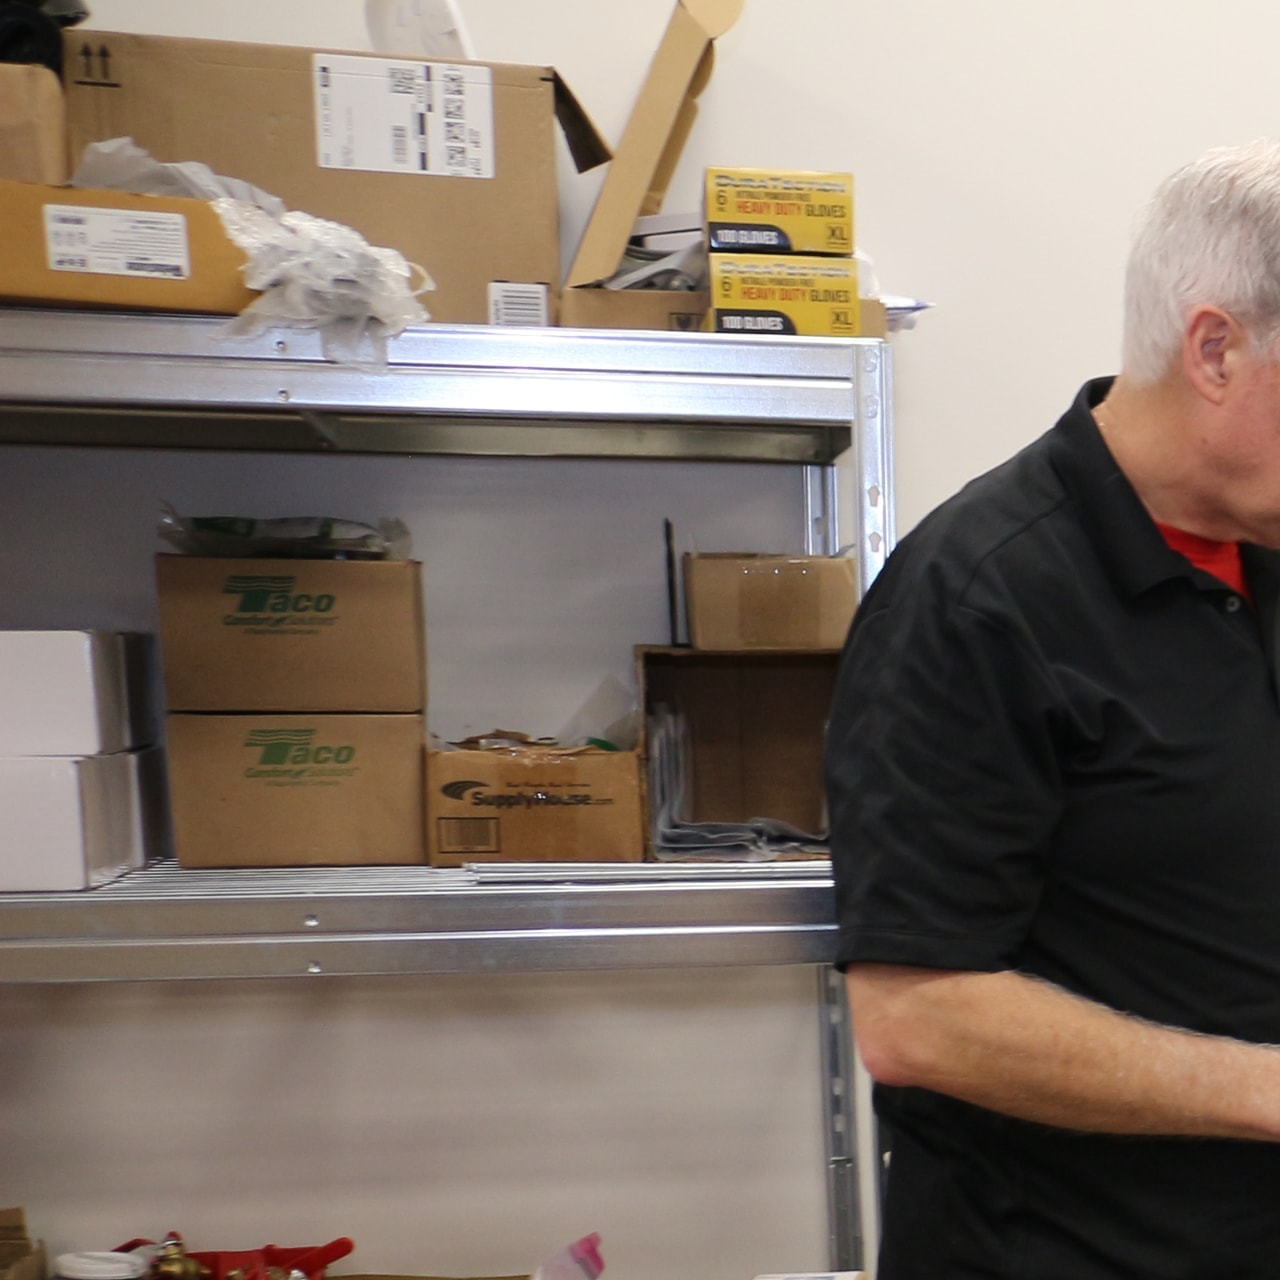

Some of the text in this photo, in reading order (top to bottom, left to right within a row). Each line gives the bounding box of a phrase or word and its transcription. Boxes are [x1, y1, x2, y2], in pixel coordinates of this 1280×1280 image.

[736, 202, 772, 214] HEAVY
[775, 203, 802, 216] DUTY
[805, 205, 847, 218] GLOVES
[716, 230, 779, 245] 100 GLOVES
[827, 227, 848, 241] XL
[741, 287, 776, 300] HEAVY
[779, 288, 806, 301] DUTY
[809, 290, 850, 303] GLOVES
[722, 316, 784, 330] 100 GLOVES
[832, 311, 853, 325] XL
[223, 576, 336, 613] Taco
[244, 728, 356, 765] Taco
